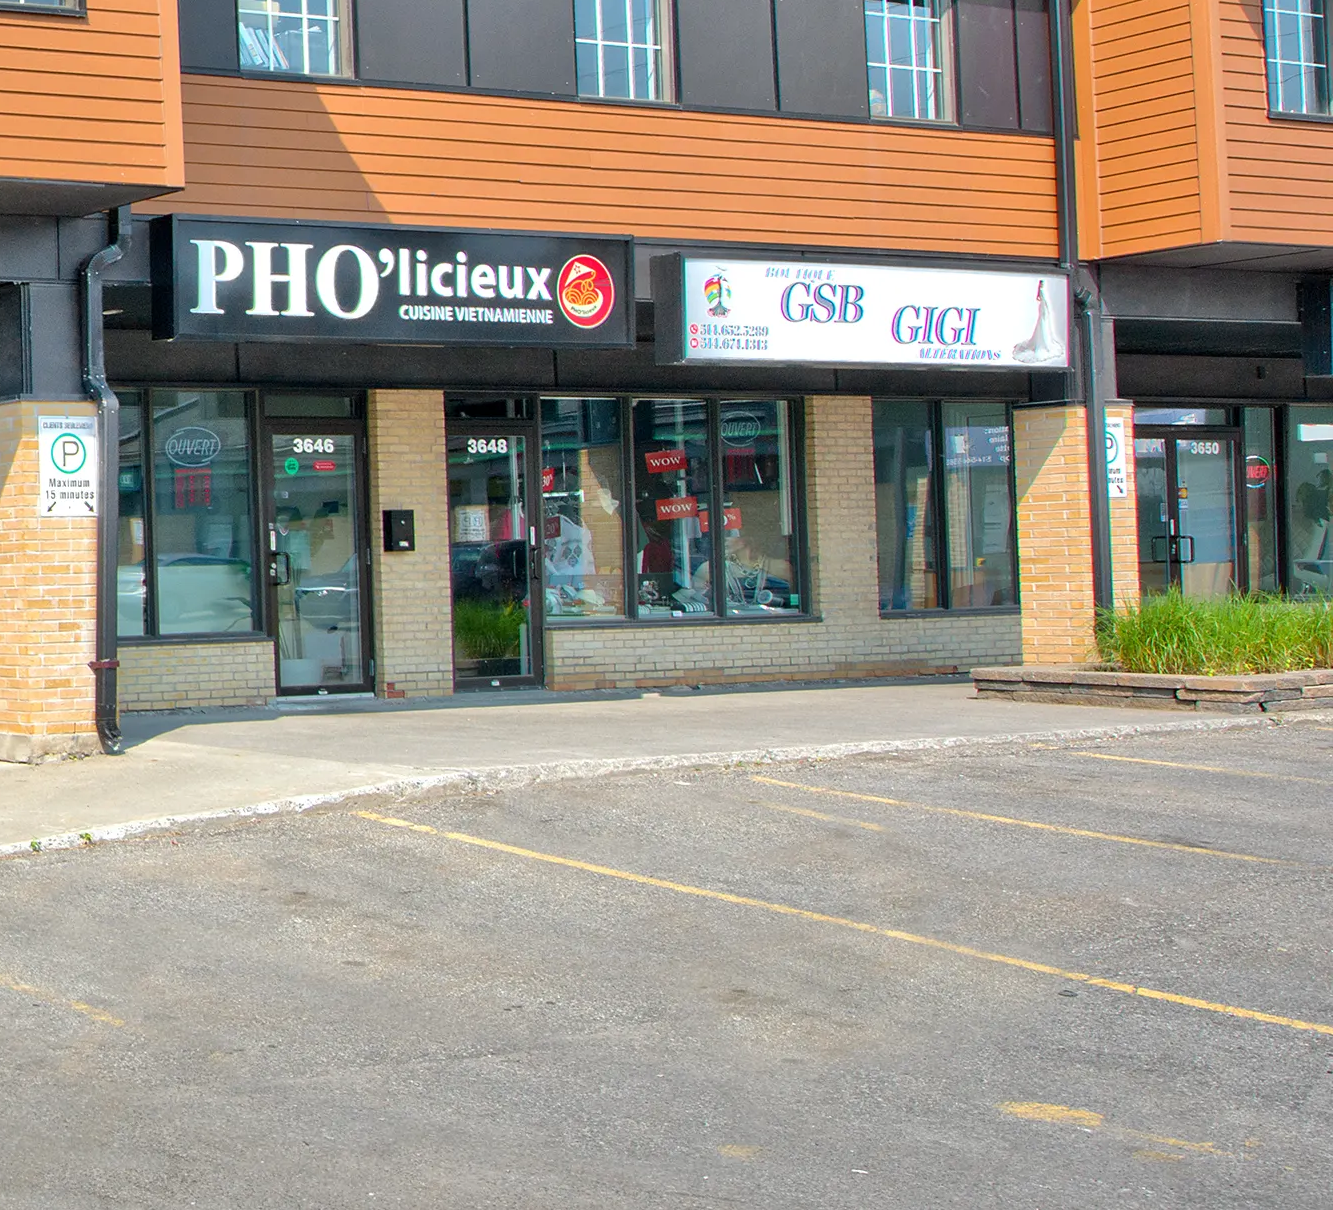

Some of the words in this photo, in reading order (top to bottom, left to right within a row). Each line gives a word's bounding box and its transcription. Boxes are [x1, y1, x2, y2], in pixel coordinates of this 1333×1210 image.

[780, 281, 865, 324] GSB
[399, 304, 454, 321] CUISINE
[455, 306, 554, 324] VIETNAMIENNE
[891, 304, 981, 346] GIGI
[169, 438, 217, 455] OUVERT
[293, 438, 334, 453] 3646
[467, 438, 508, 454] 3648
[1191, 441, 1221, 455] 3650
[62, 441, 80, 467] P
[650, 456, 681, 467] WOW
[49, 478, 90, 488] Maximum
[46, 490, 56, 499] 15
[60, 491, 95, 499] minutes
[660, 503, 692, 514] WOW
